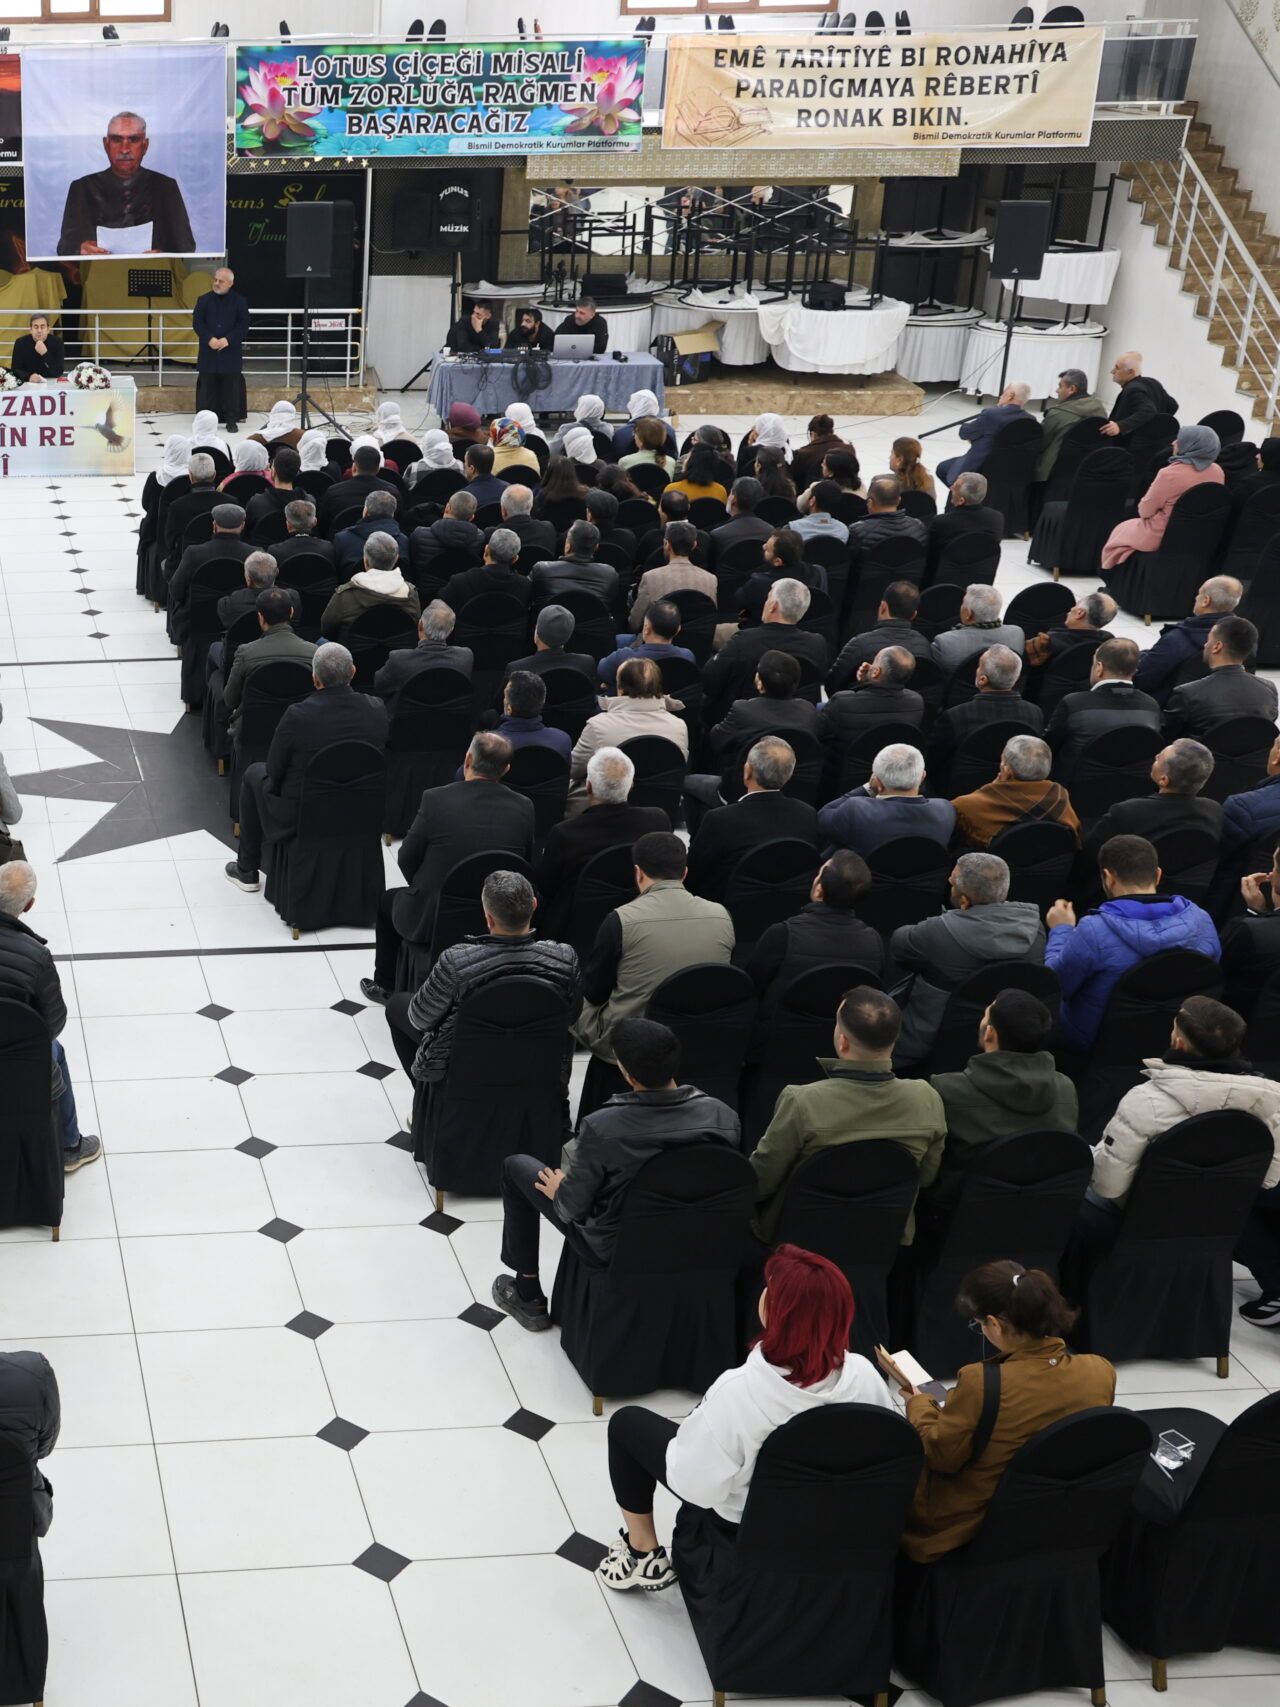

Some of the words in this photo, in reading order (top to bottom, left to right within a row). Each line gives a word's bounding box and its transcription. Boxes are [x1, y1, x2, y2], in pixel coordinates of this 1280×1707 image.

[297, 54, 386, 78] LOTUS
[393, 48, 483, 83] ÇİÇEĞİ
[491, 47, 585, 76] MİSALİ
[714, 45, 766, 68] EMÊ
[776, 45, 892, 68] TARÎTÎYÊ
[901, 47, 925, 67] BI
[935, 39, 1068, 66] RONAHÎYA
[282, 82, 342, 107] TÜM
[349, 80, 476, 107] ZORLUĞA
[483, 79, 597, 105] RAĞMEN
[735, 75, 915, 98] PARADÎGMAYA
[924, 70, 1040, 96] RÊBERTÎ
[346, 108, 531, 141] BAŞARACAĞIZ
[796, 107, 883, 127] RONAK
[892, 106, 968, 127] BIKIN.
[467, 142, 493, 150] Bismil
[494, 141, 544, 149] Demokratik
[546, 141, 585, 149] Kurumlar
[587, 140, 629, 148] Platformu
[913, 132, 939, 140] Bismil
[941, 131, 992, 140] Demokratik
[994, 131, 1035, 139] Kurumlar
[1037, 130, 1082, 139] Platformu
[439, 186, 469, 200] YUNUS
[39, 426, 75, 447] RE
